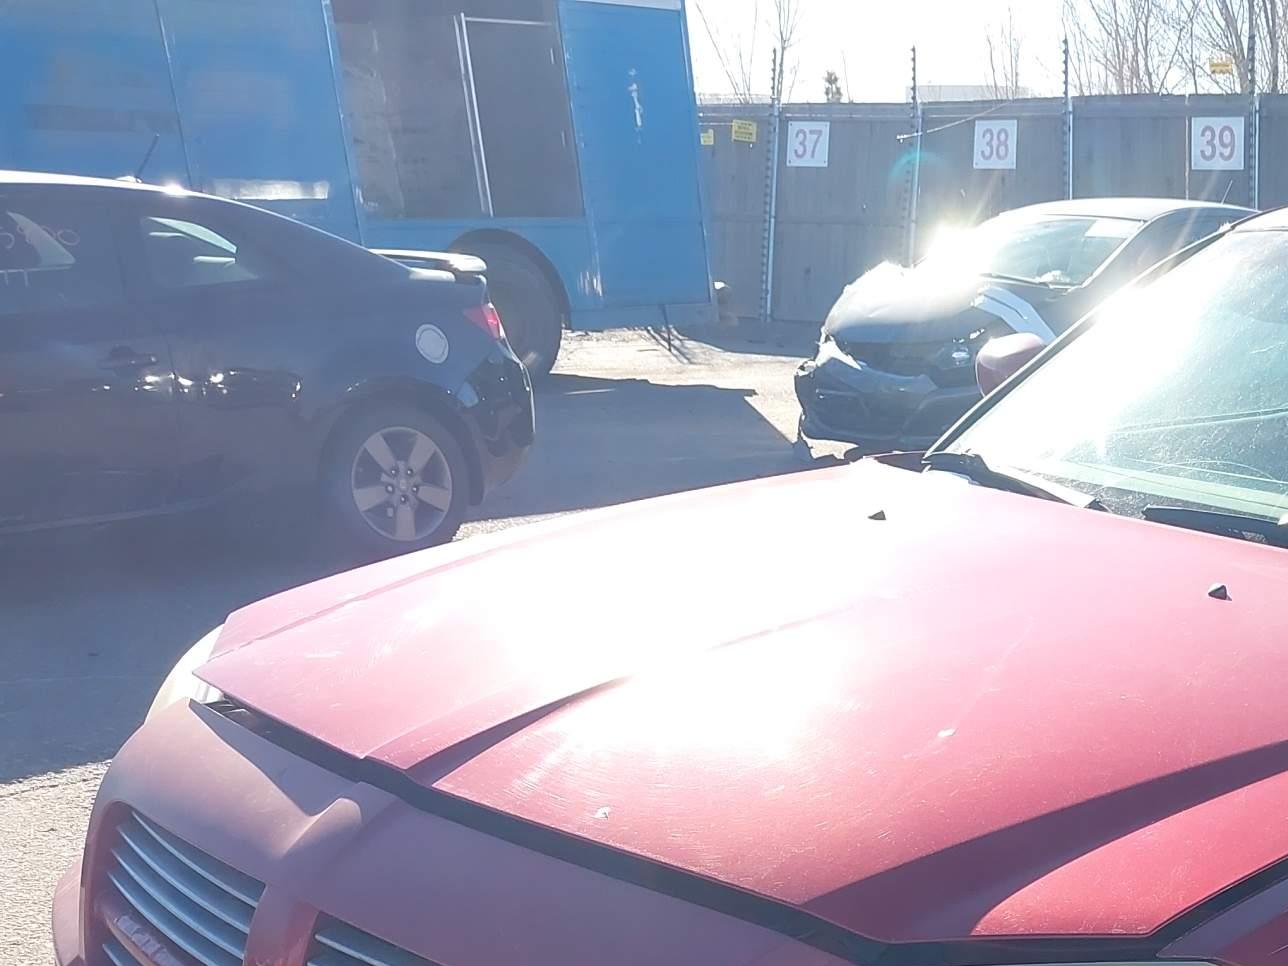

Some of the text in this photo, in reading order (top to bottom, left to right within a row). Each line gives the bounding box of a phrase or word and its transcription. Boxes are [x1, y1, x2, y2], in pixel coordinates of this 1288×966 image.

[794, 128, 823, 159] 37
[980, 128, 1009, 160] 38
[1200, 125, 1236, 161] 39
